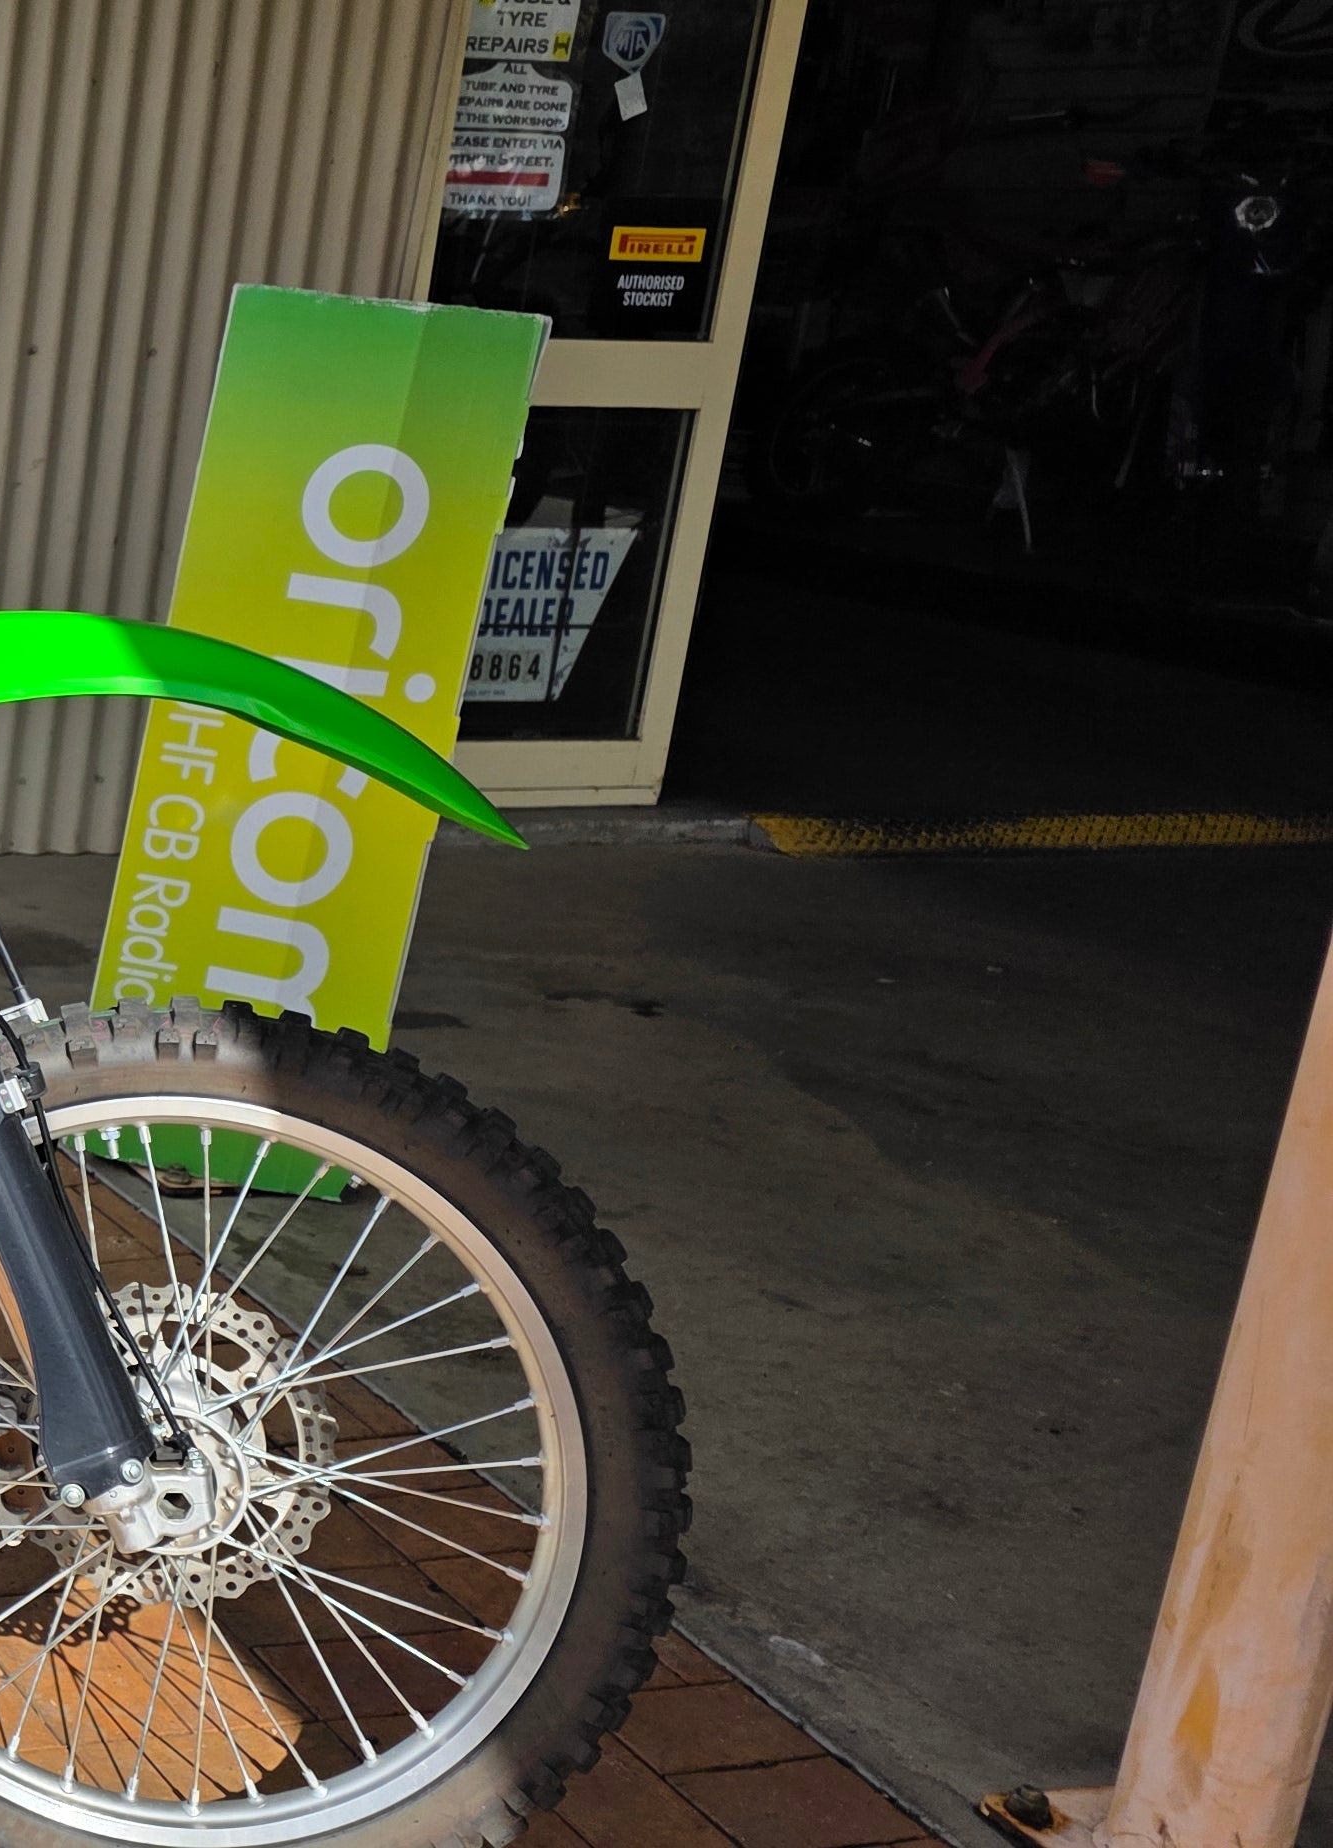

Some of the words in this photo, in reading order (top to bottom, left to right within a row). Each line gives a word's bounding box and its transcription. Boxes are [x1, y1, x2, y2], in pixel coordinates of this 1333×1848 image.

[497, 10, 548, 28] TYRE
[466, 36, 549, 54] REPAIRS
[504, 63, 527, 75] ALL
[501, 83, 526, 94] AND
[529, 85, 559, 97] TYRE
[458, 96, 504, 107] EPAIRS
[506, 99, 530, 110] ARE
[533, 101, 568, 112] DONE
[466, 113, 489, 124] THE
[493, 137, 537, 149] ENTER
[541, 140, 563, 149] VIA
[618, 233, 697, 255] PIRELLI
[617, 275, 685, 292] AUTHORISED
[623, 291, 674, 307] STOCKIST
[490, 551, 610, 590] ICENSED
[160, 701, 225, 786] HF
[143, 794, 205, 861] CB
